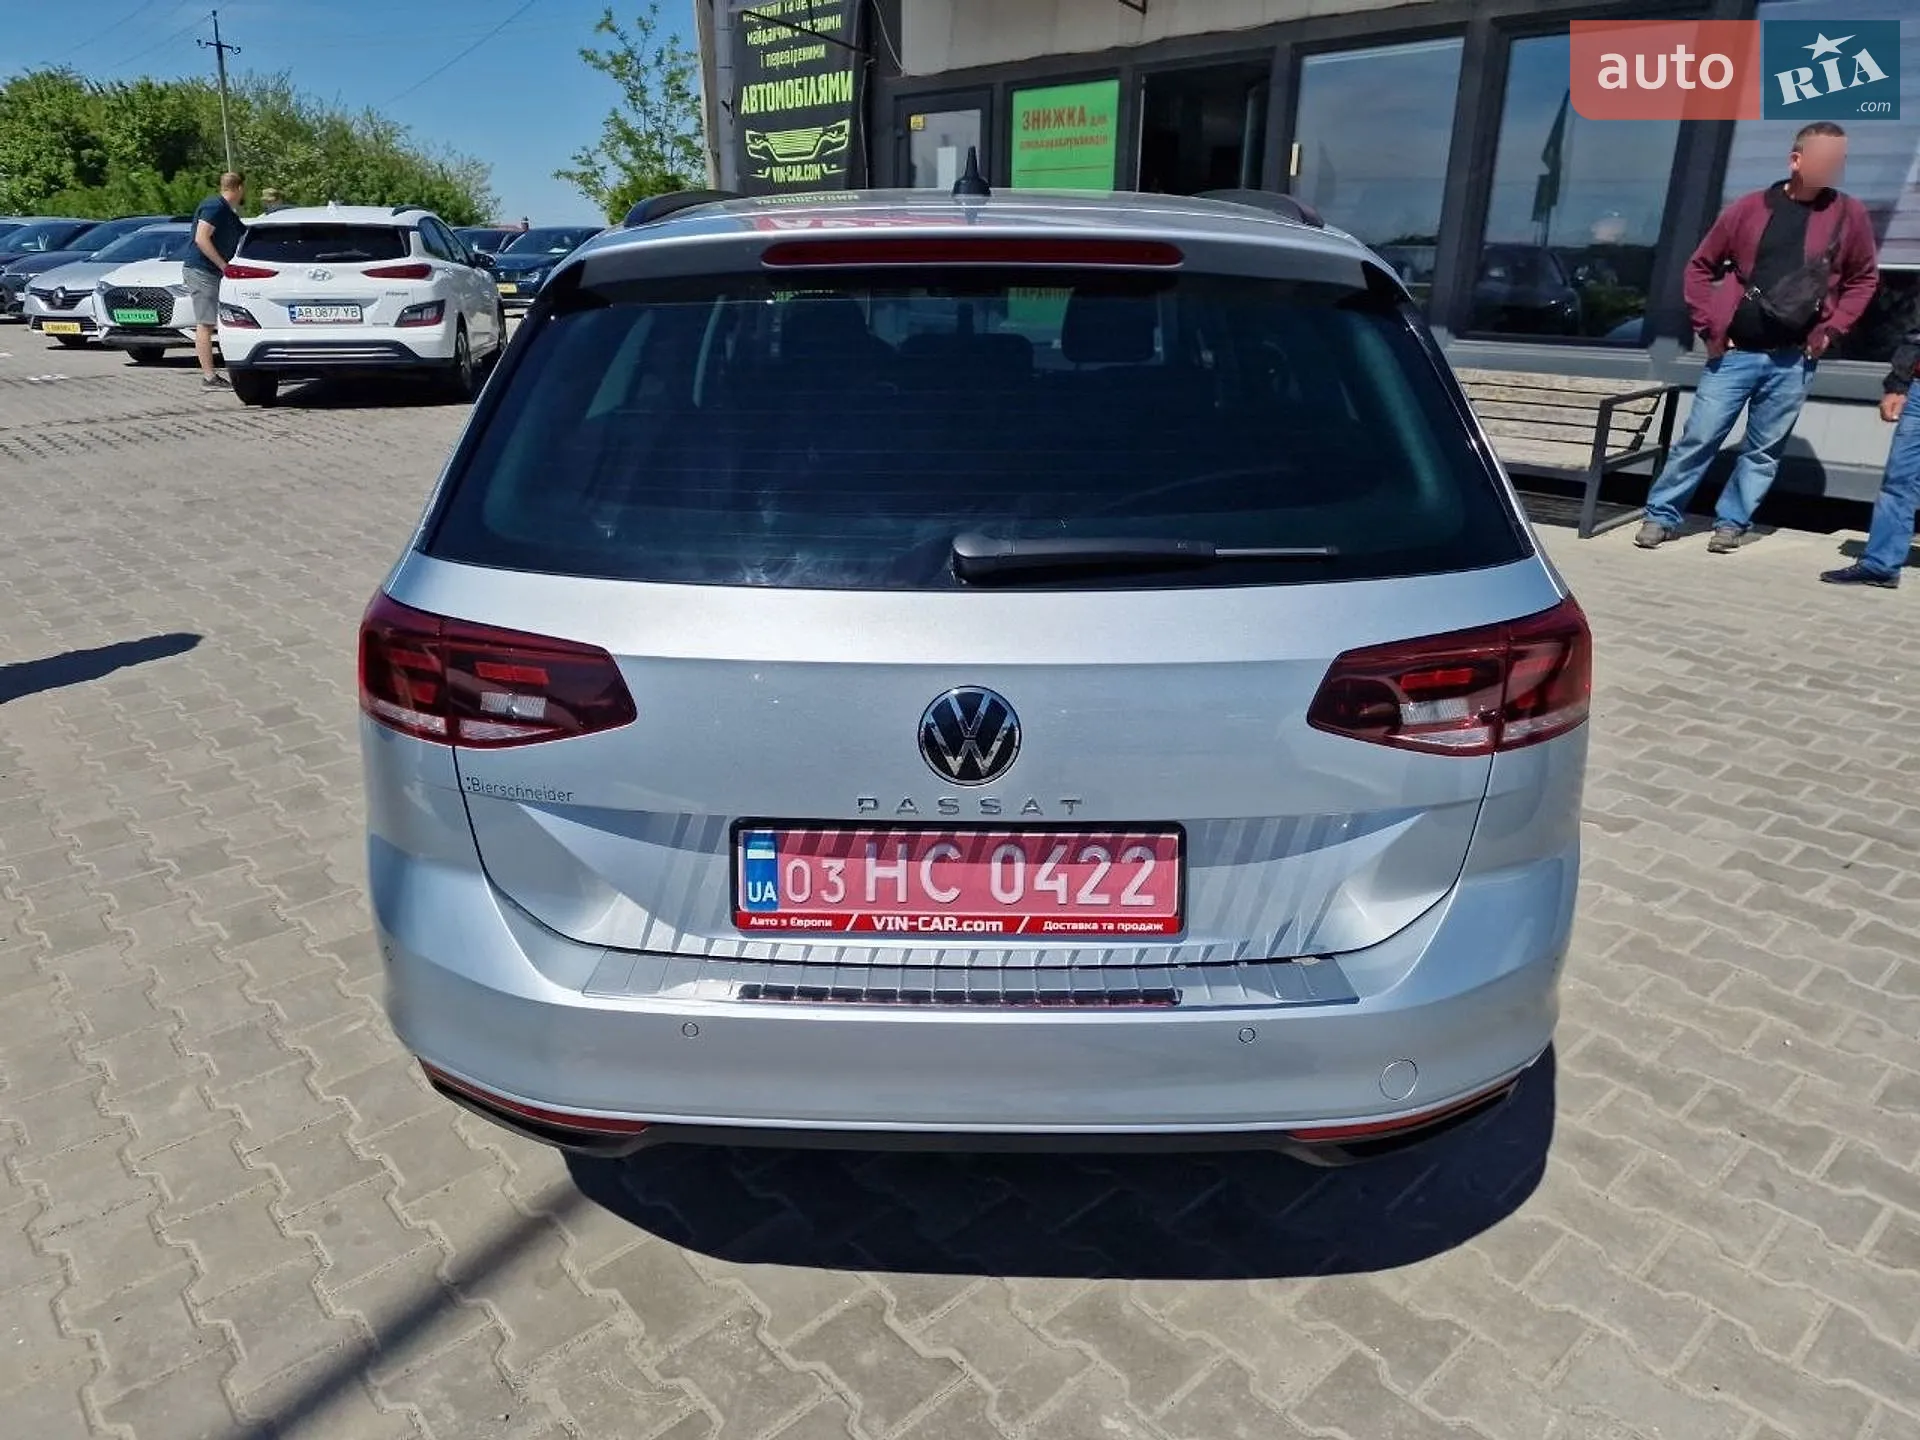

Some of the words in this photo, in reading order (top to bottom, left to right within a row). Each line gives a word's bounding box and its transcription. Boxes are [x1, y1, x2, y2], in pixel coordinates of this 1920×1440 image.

[741, 70, 854, 115] АВТОМОБІЛЯМИ
[1022, 105, 1087, 131] ЗНИЖКА
[857, 796, 1083, 816] PASSAT
[747, 880, 778, 903] UA
[785, 858, 847, 904] 03
[865, 842, 962, 904] HC
[990, 843, 1156, 906] 0422
[749, 916, 778, 927] Авто
[789, 916, 833, 929] Європи
[872, 916, 1004, 932] VIN-CAR.com
[1042, 920, 1099, 932] Доставка
[1101, 922, 1115, 931] та
[1117, 922, 1164, 933] продаж
